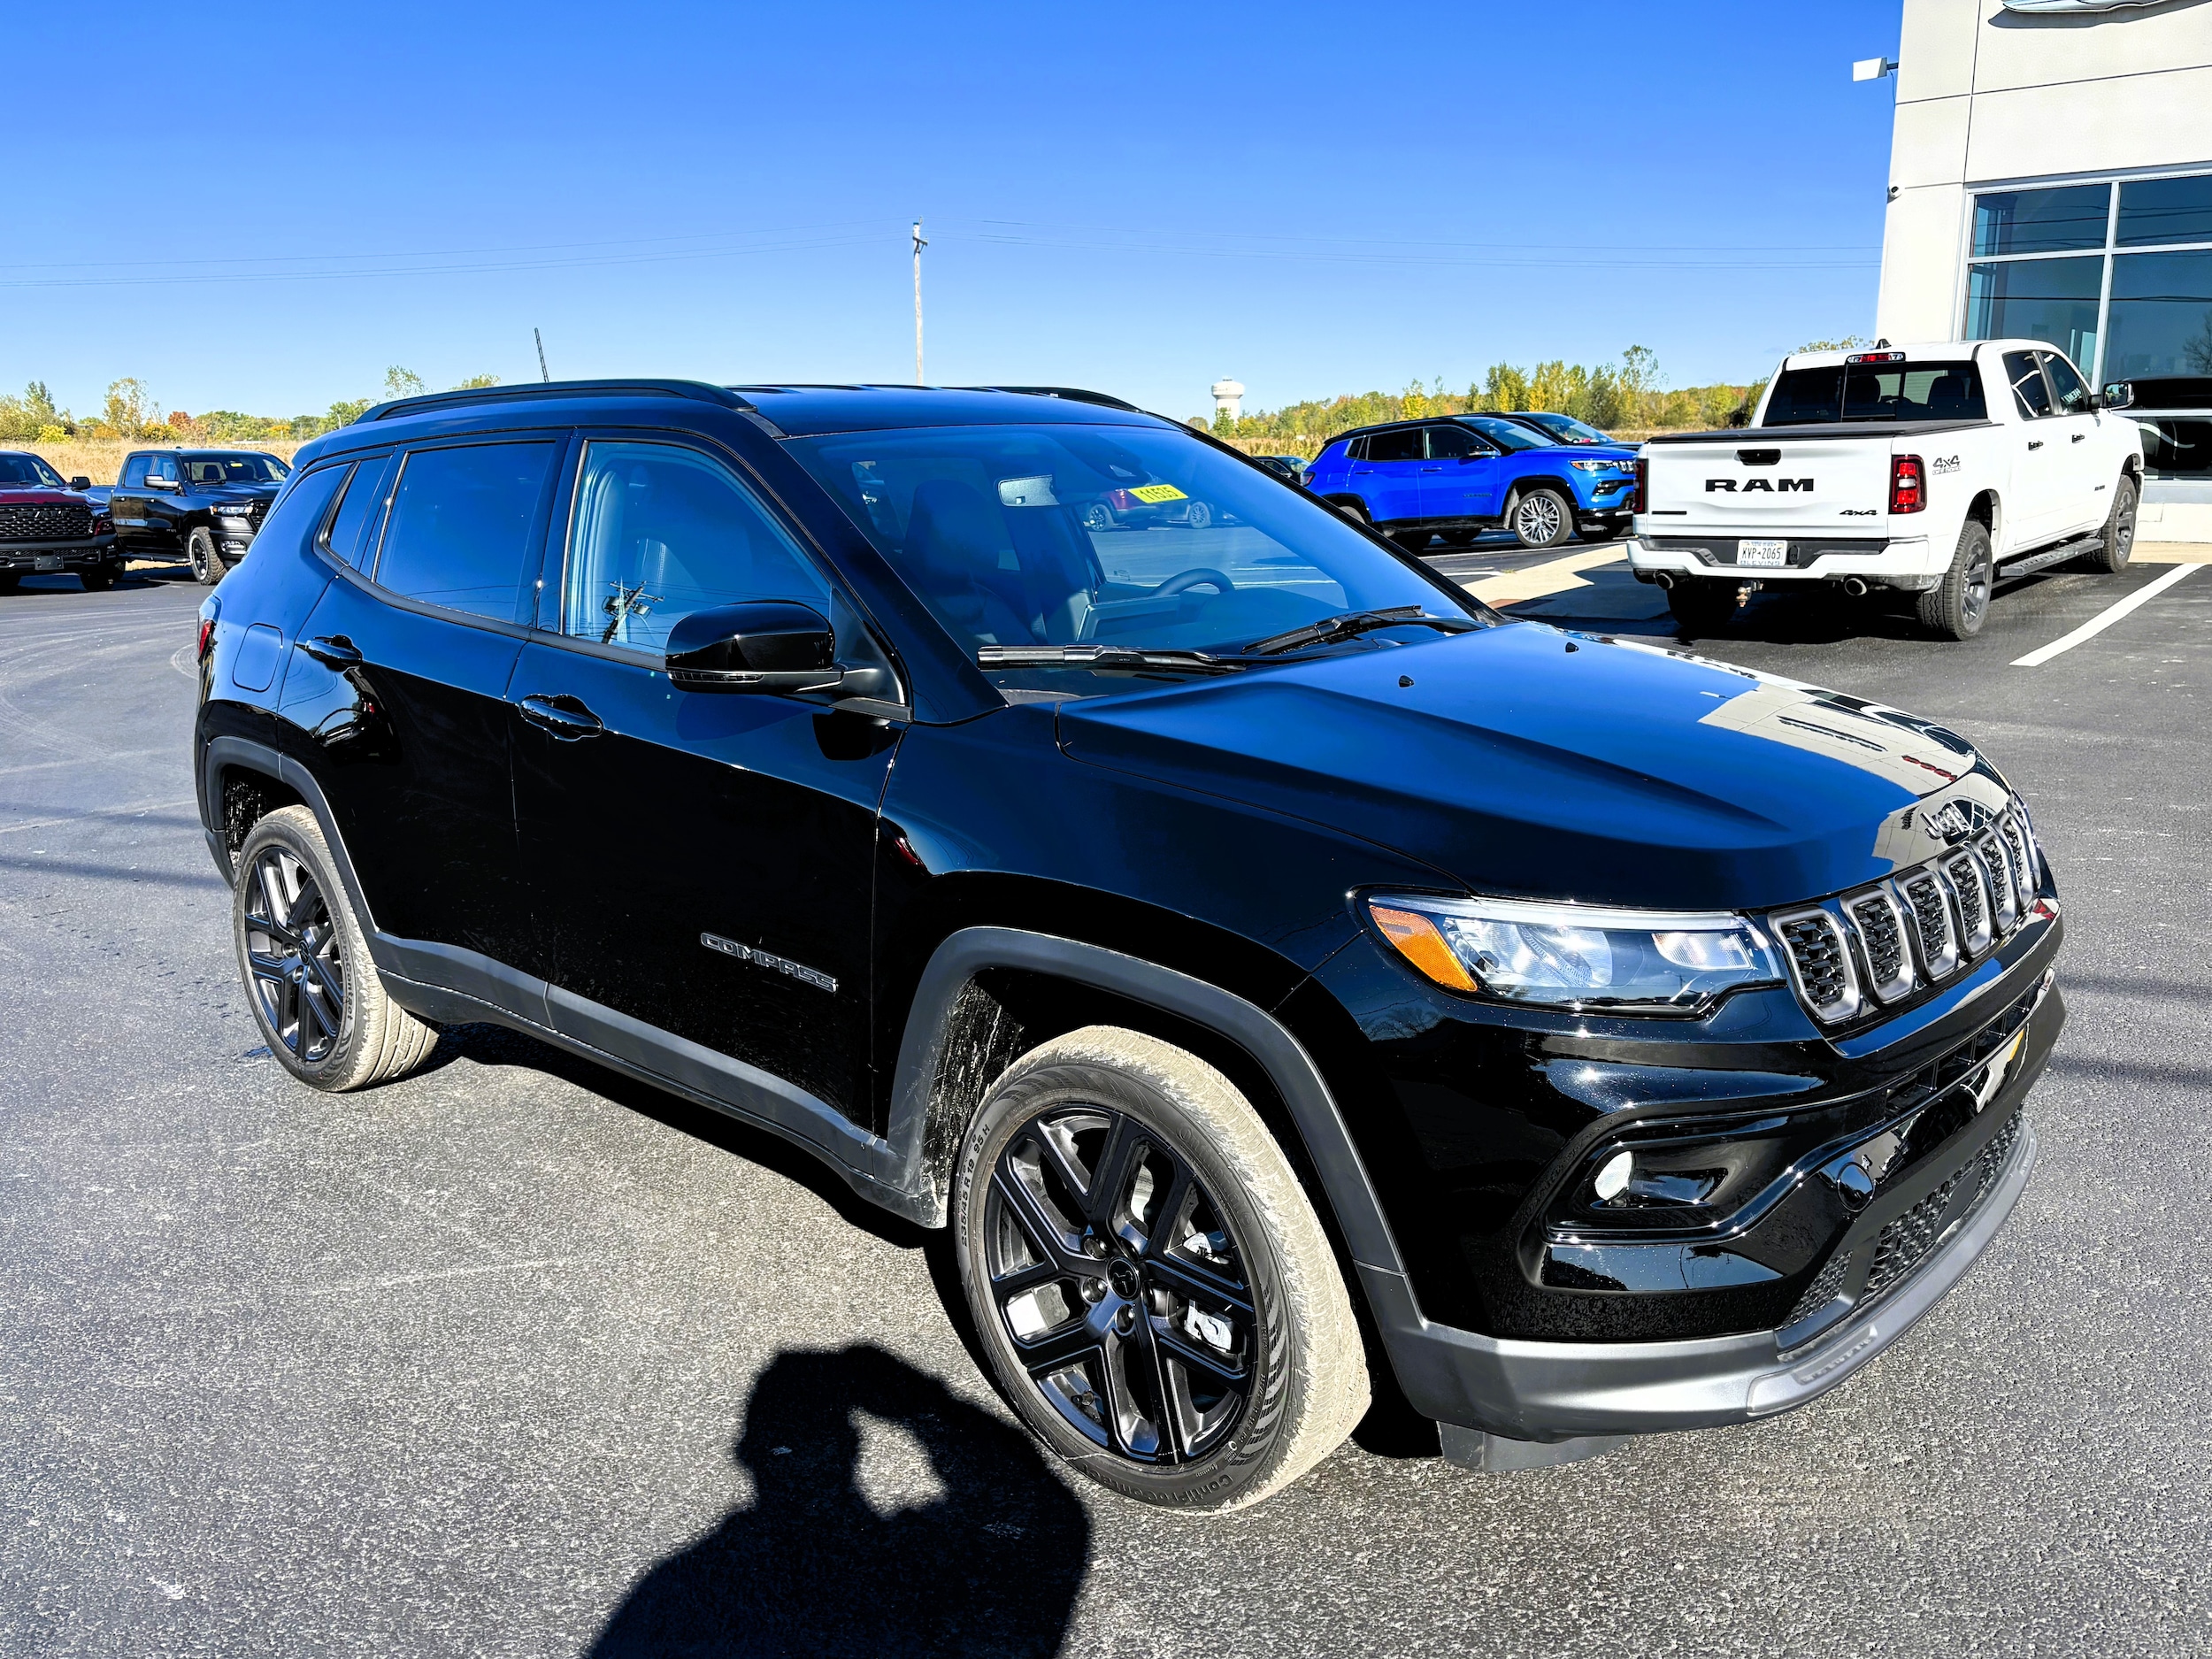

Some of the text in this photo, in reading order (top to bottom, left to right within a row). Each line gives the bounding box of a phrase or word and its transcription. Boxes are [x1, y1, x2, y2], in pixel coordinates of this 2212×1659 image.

[1139, 487, 1179, 501] 11535
[1705, 478, 1814, 492] RAM
[1919, 805, 1966, 840] Jeep
[700, 932, 839, 993] COMPASS
[959, 1191, 972, 1247] 235/45
[967, 1158, 977, 1175] 19
[973, 1136, 986, 1155] 95
[980, 1123, 991, 1137] H
